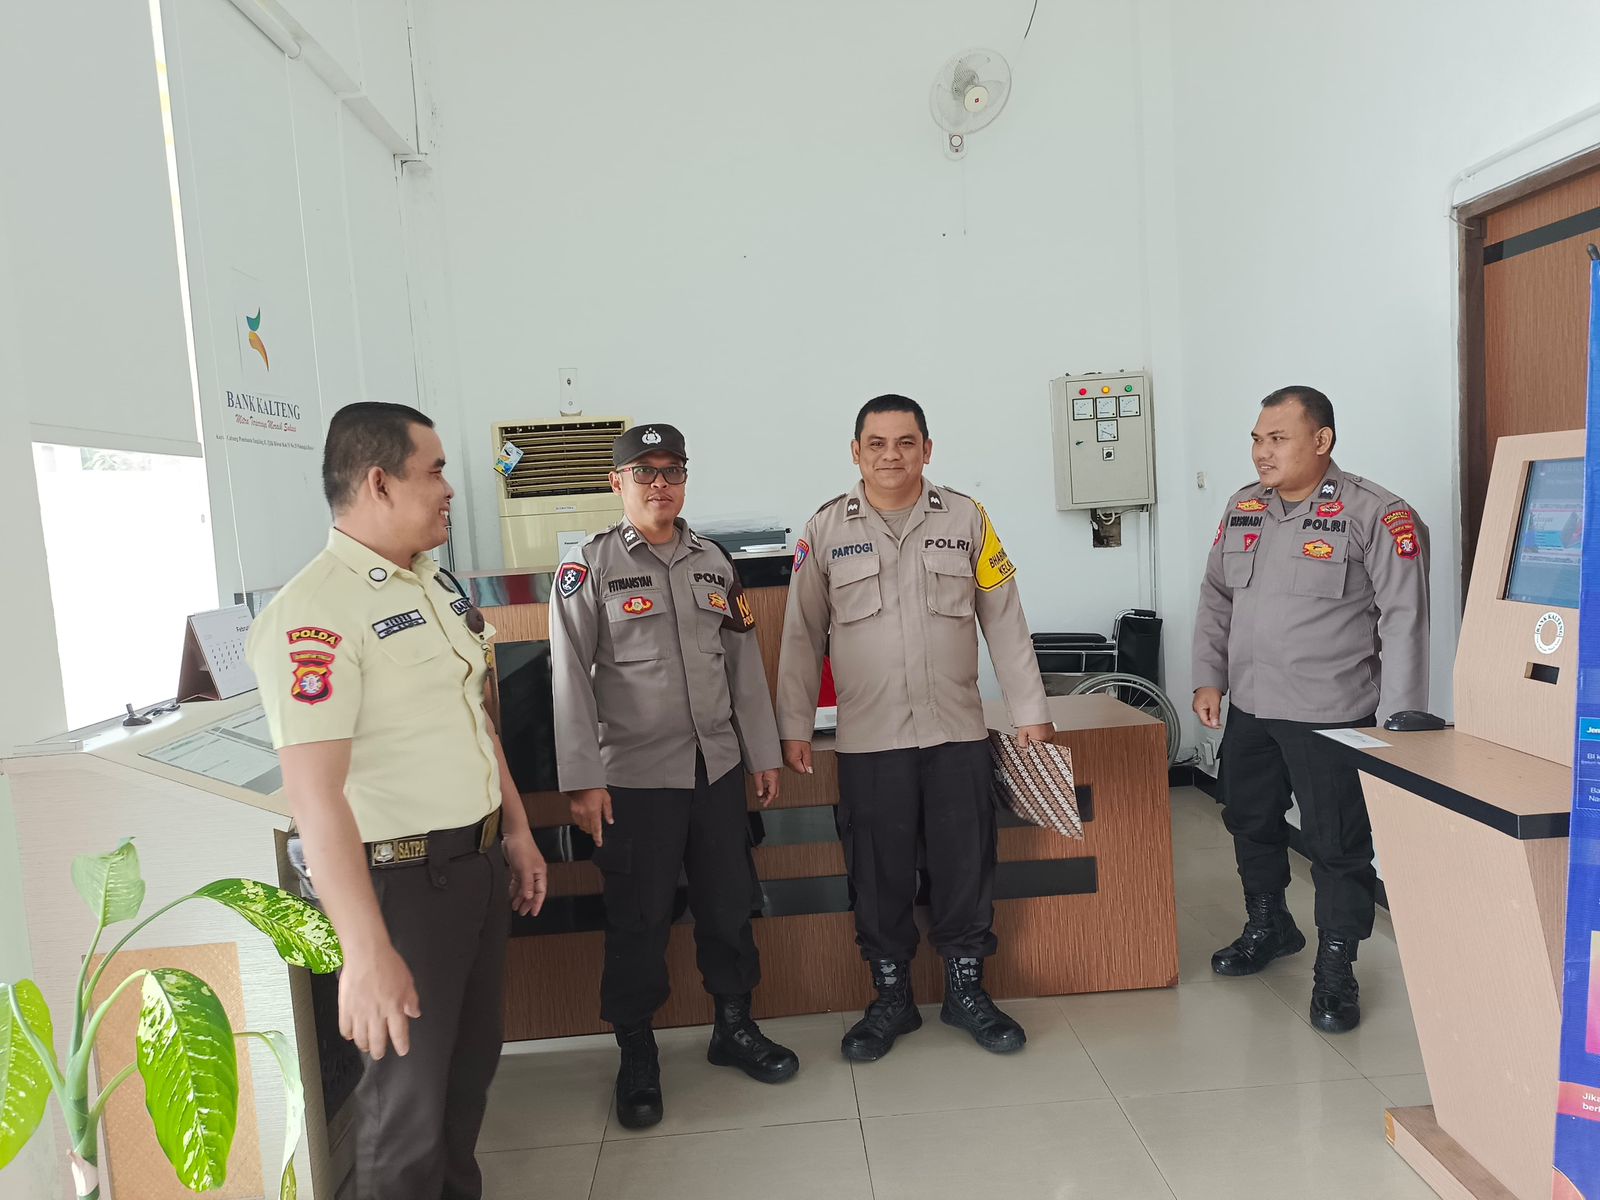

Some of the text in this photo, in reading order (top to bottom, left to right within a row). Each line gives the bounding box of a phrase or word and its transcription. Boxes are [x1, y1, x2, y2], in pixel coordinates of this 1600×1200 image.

[226, 390, 301, 420] BANK KALTENG
[1302, 518, 1347, 533] POLRI
[831, 542, 873, 560] PARTOGI
[924, 538, 970, 552] POLRI
[608, 575, 653, 593] FITRIANSYAH
[291, 629, 337, 645] POLDA
[398, 839, 428, 860] SATPA
